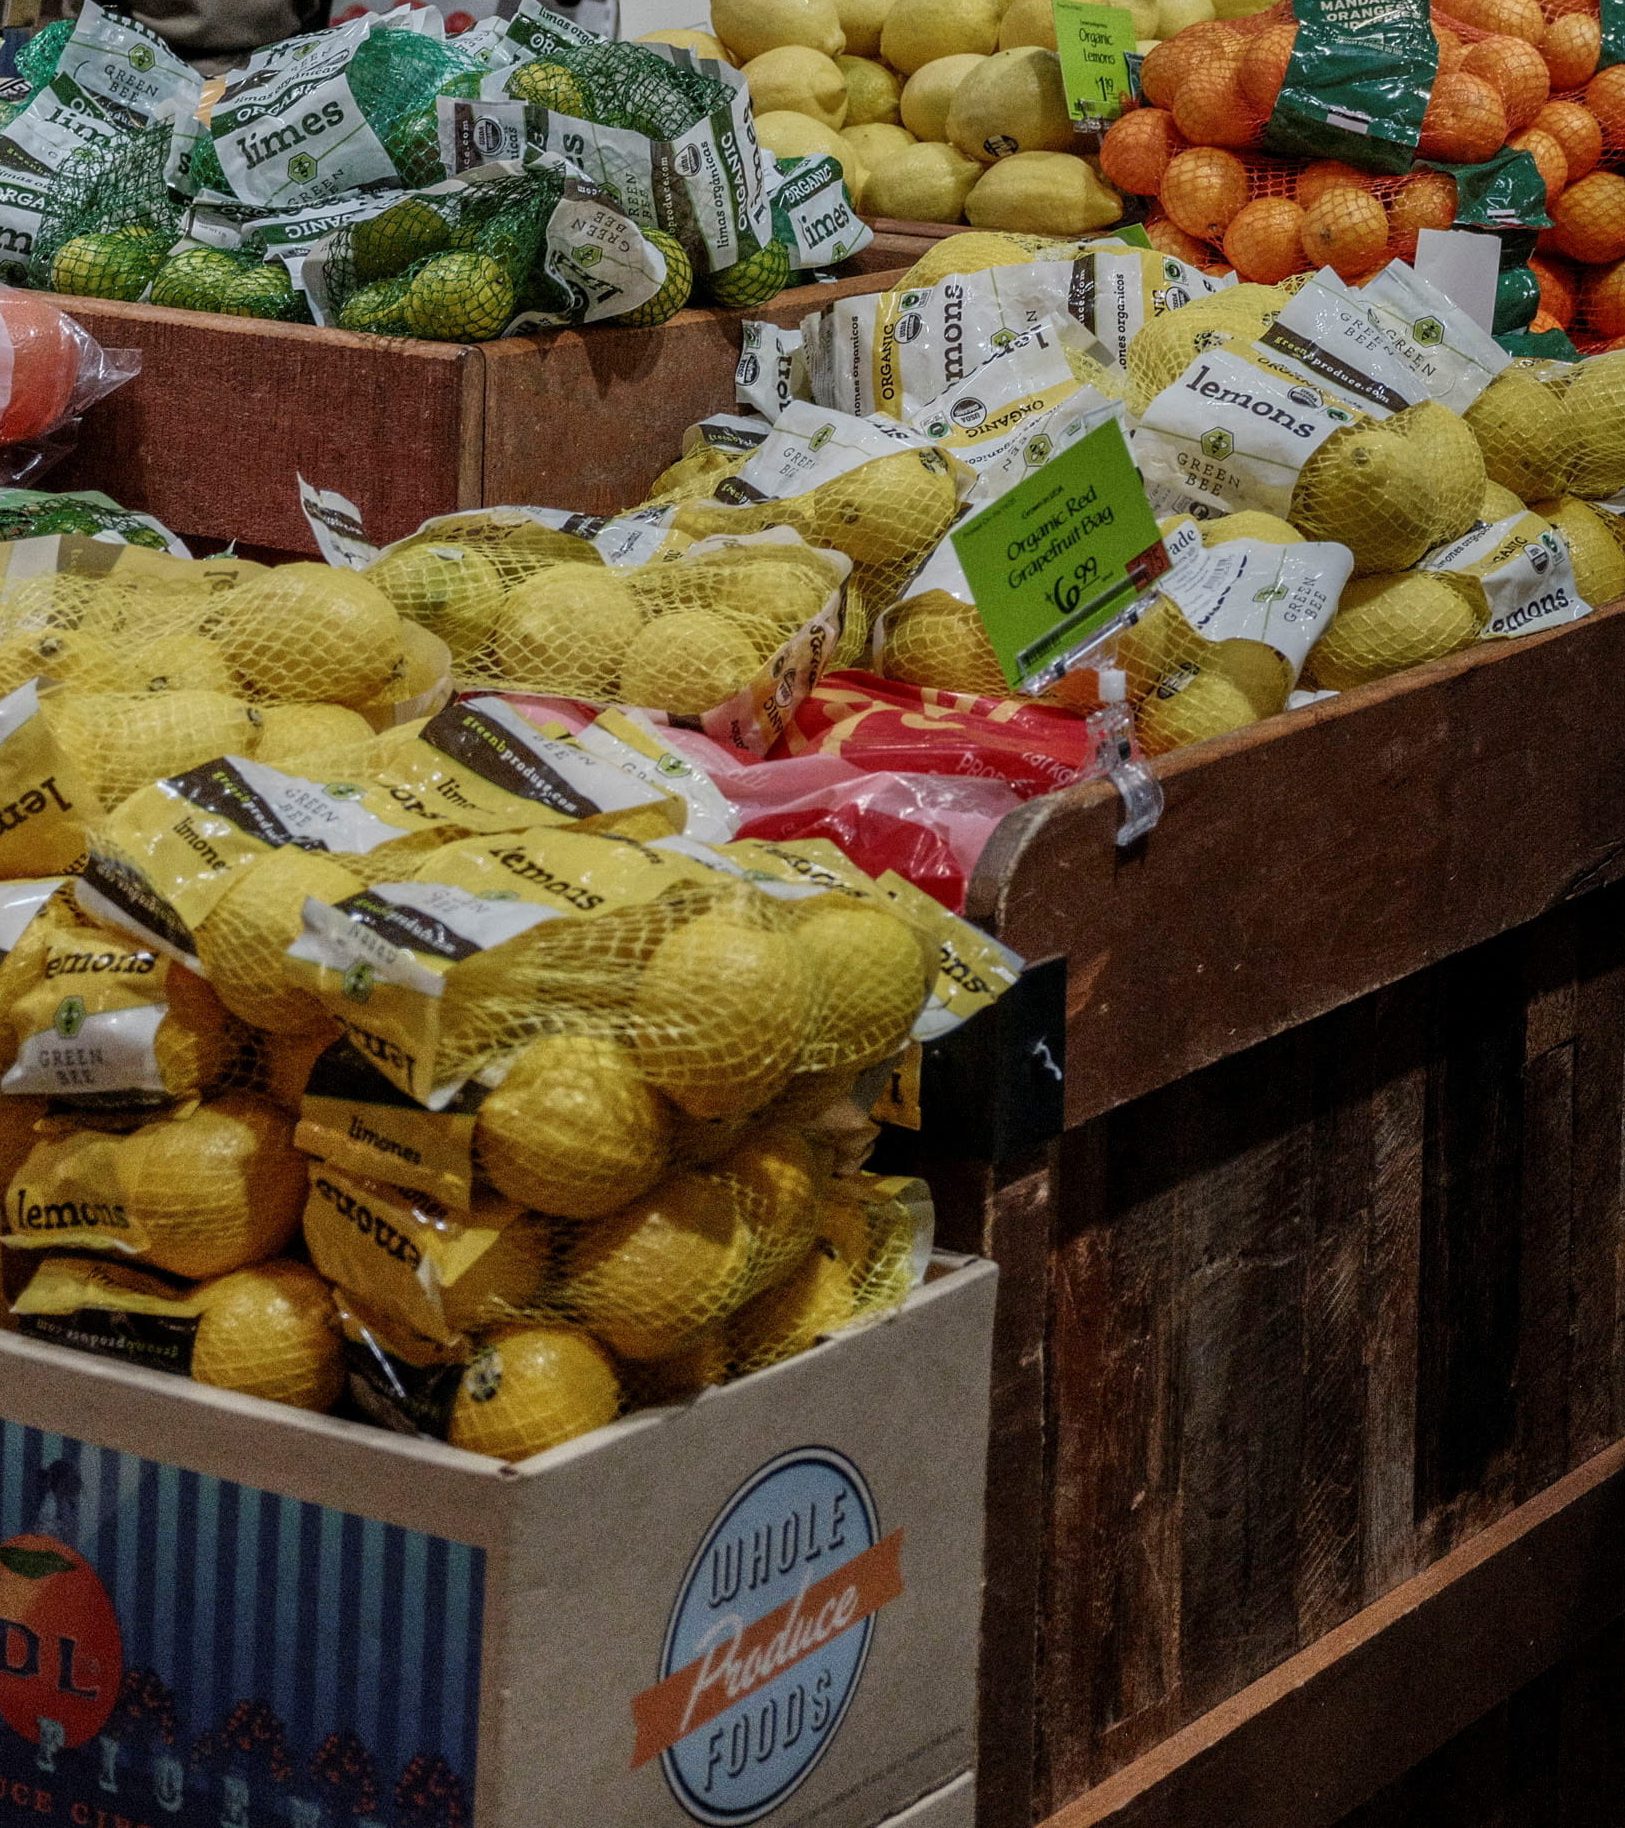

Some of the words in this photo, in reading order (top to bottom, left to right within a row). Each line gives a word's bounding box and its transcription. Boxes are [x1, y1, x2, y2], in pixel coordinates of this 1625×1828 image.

[1078, 26, 1114, 48] Organic
[1083, 48, 1116, 66] Lemons
[102, 63, 162, 99] GREEN
[107, 80, 142, 105] BEE
[241, 98, 347, 170] limes
[720, 128, 749, 232] ORGANIC
[715, 210, 729, 250] limas
[800, 201, 851, 251] limes
[880, 322, 896, 402] ORGANIC
[1183, 364, 1317, 443] lemons
[1175, 452, 1244, 493] GREEN
[1183, 472, 1226, 497] BEE
[1004, 510, 1060, 562] Organic
[1061, 486, 1100, 522] Red
[1006, 525, 1082, 593] Grapefruit
[1083, 505, 1116, 539] Bag
[38, 1046, 104, 1072] GREEN
[348, 1115, 423, 1167] limones
[16, 1188, 130, 1231] lemons
[707, 1486, 849, 1610] WHOLE
[678, 1566, 860, 1734] Produce
[702, 1667, 834, 1794] FOODS
